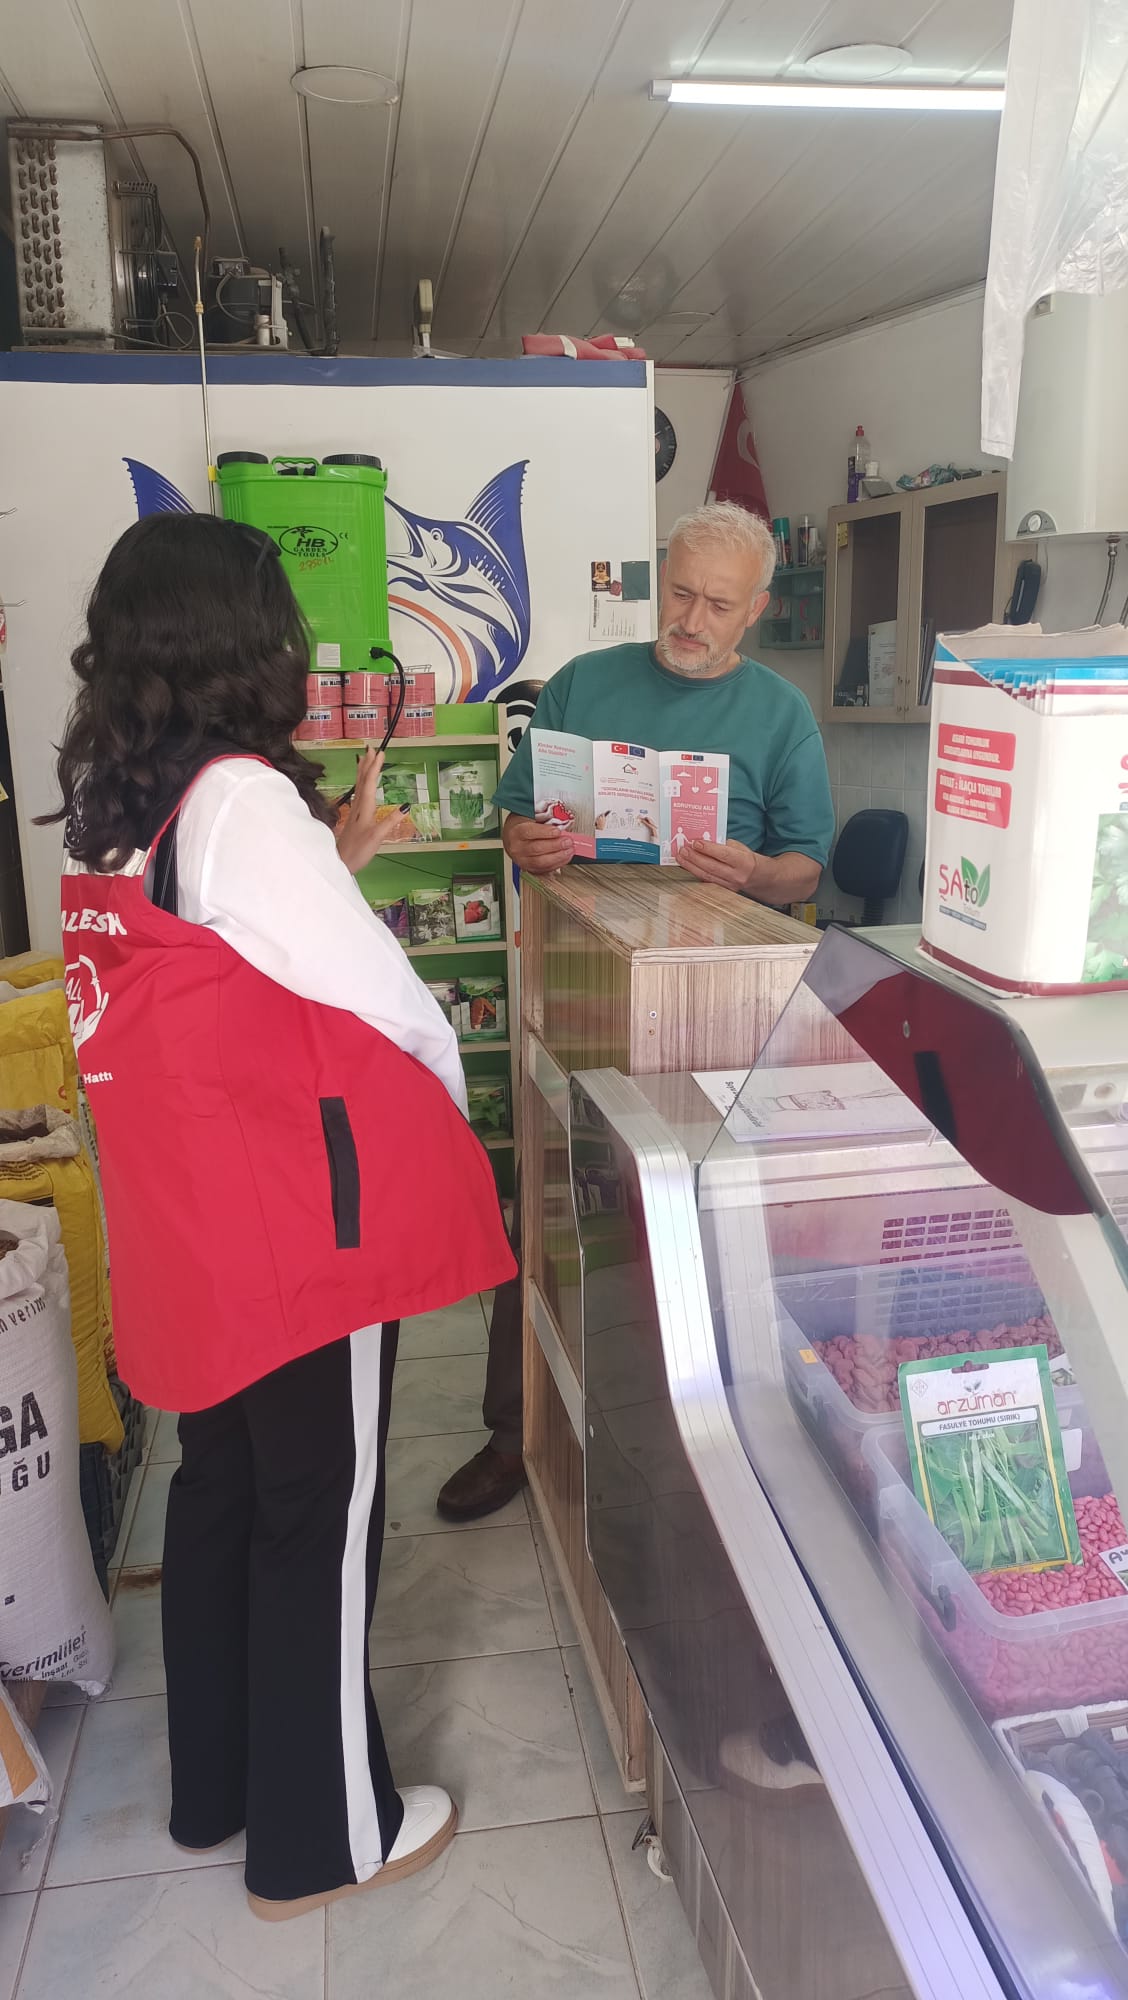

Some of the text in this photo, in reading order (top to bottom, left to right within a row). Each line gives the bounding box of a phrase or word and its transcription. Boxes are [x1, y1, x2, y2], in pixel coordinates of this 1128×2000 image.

[296, 538, 326, 548] HB
[939, 1421, 968, 1431] FASULYE
[968, 1417, 996, 1427] TOHUMU
